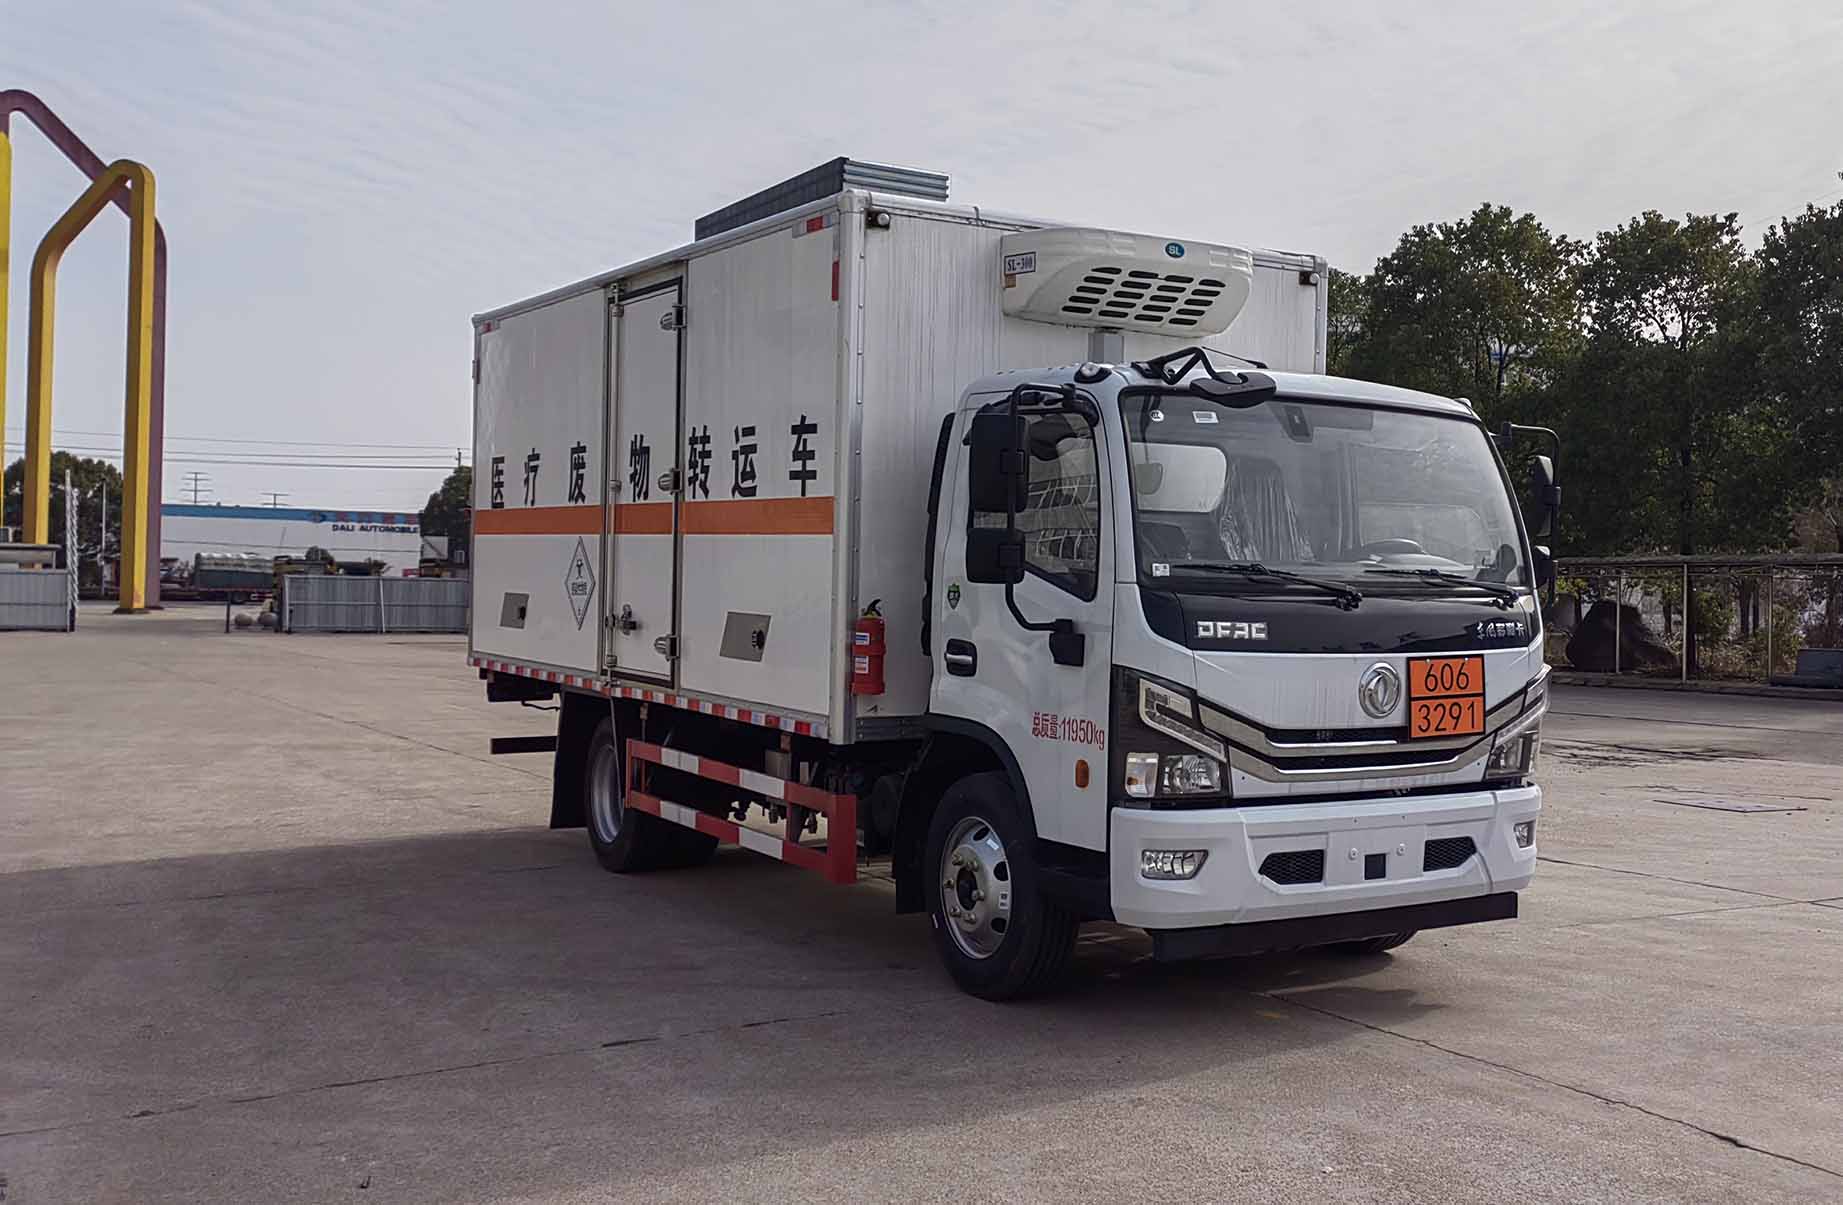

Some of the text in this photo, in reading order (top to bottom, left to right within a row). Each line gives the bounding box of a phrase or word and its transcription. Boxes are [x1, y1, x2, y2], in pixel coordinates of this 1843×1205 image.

[1168, 245, 1182, 256] SL
[490, 414, 818, 509] 医疗废物转运车
[1424, 662, 1469, 692] 606
[1418, 701, 1475, 732] 3291
